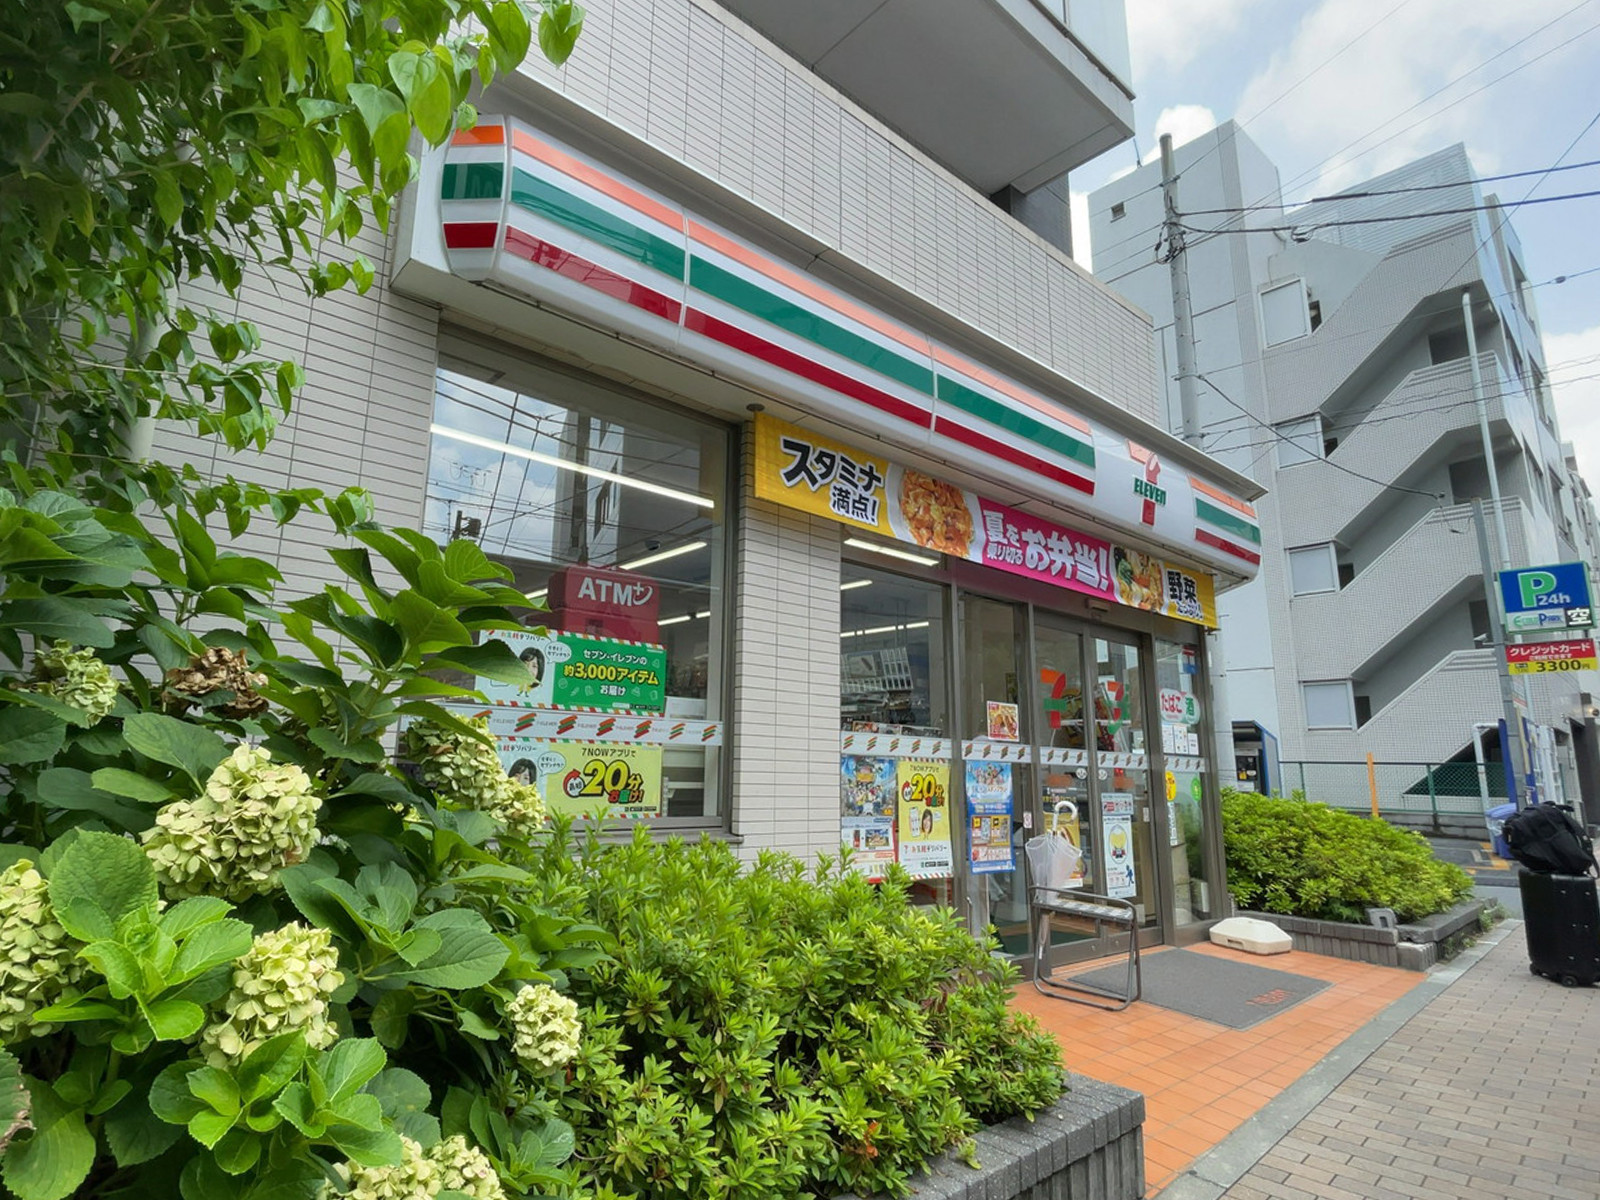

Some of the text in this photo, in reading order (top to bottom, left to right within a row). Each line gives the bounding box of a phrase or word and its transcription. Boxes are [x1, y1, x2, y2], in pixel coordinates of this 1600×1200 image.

[781, 437, 882, 493] スタミナ
[1134, 477, 1167, 506] ELEVEN
[832, 485, 878, 523] 満点!
[983, 509, 1020, 547] 夏を
[987, 542, 1023, 565] 乗り切る
[1021, 528, 1109, 592] お弁当!
[578, 577, 632, 607] ATM
[1167, 570, 1197, 604] 野菜
[1517, 571, 1557, 608] P
[1538, 592, 1571, 606] 24h
[1567, 607, 1592, 625] 空
[1510, 642, 1591, 657] クレジットカード
[563, 662, 659, 685] 約3,000アイテム
[600, 685, 626, 697] お届け
[1161, 693, 1182, 713] たばこ
[1185, 697, 1195, 716] 酒
[581, 747, 636, 758] 7NOWアプリで
